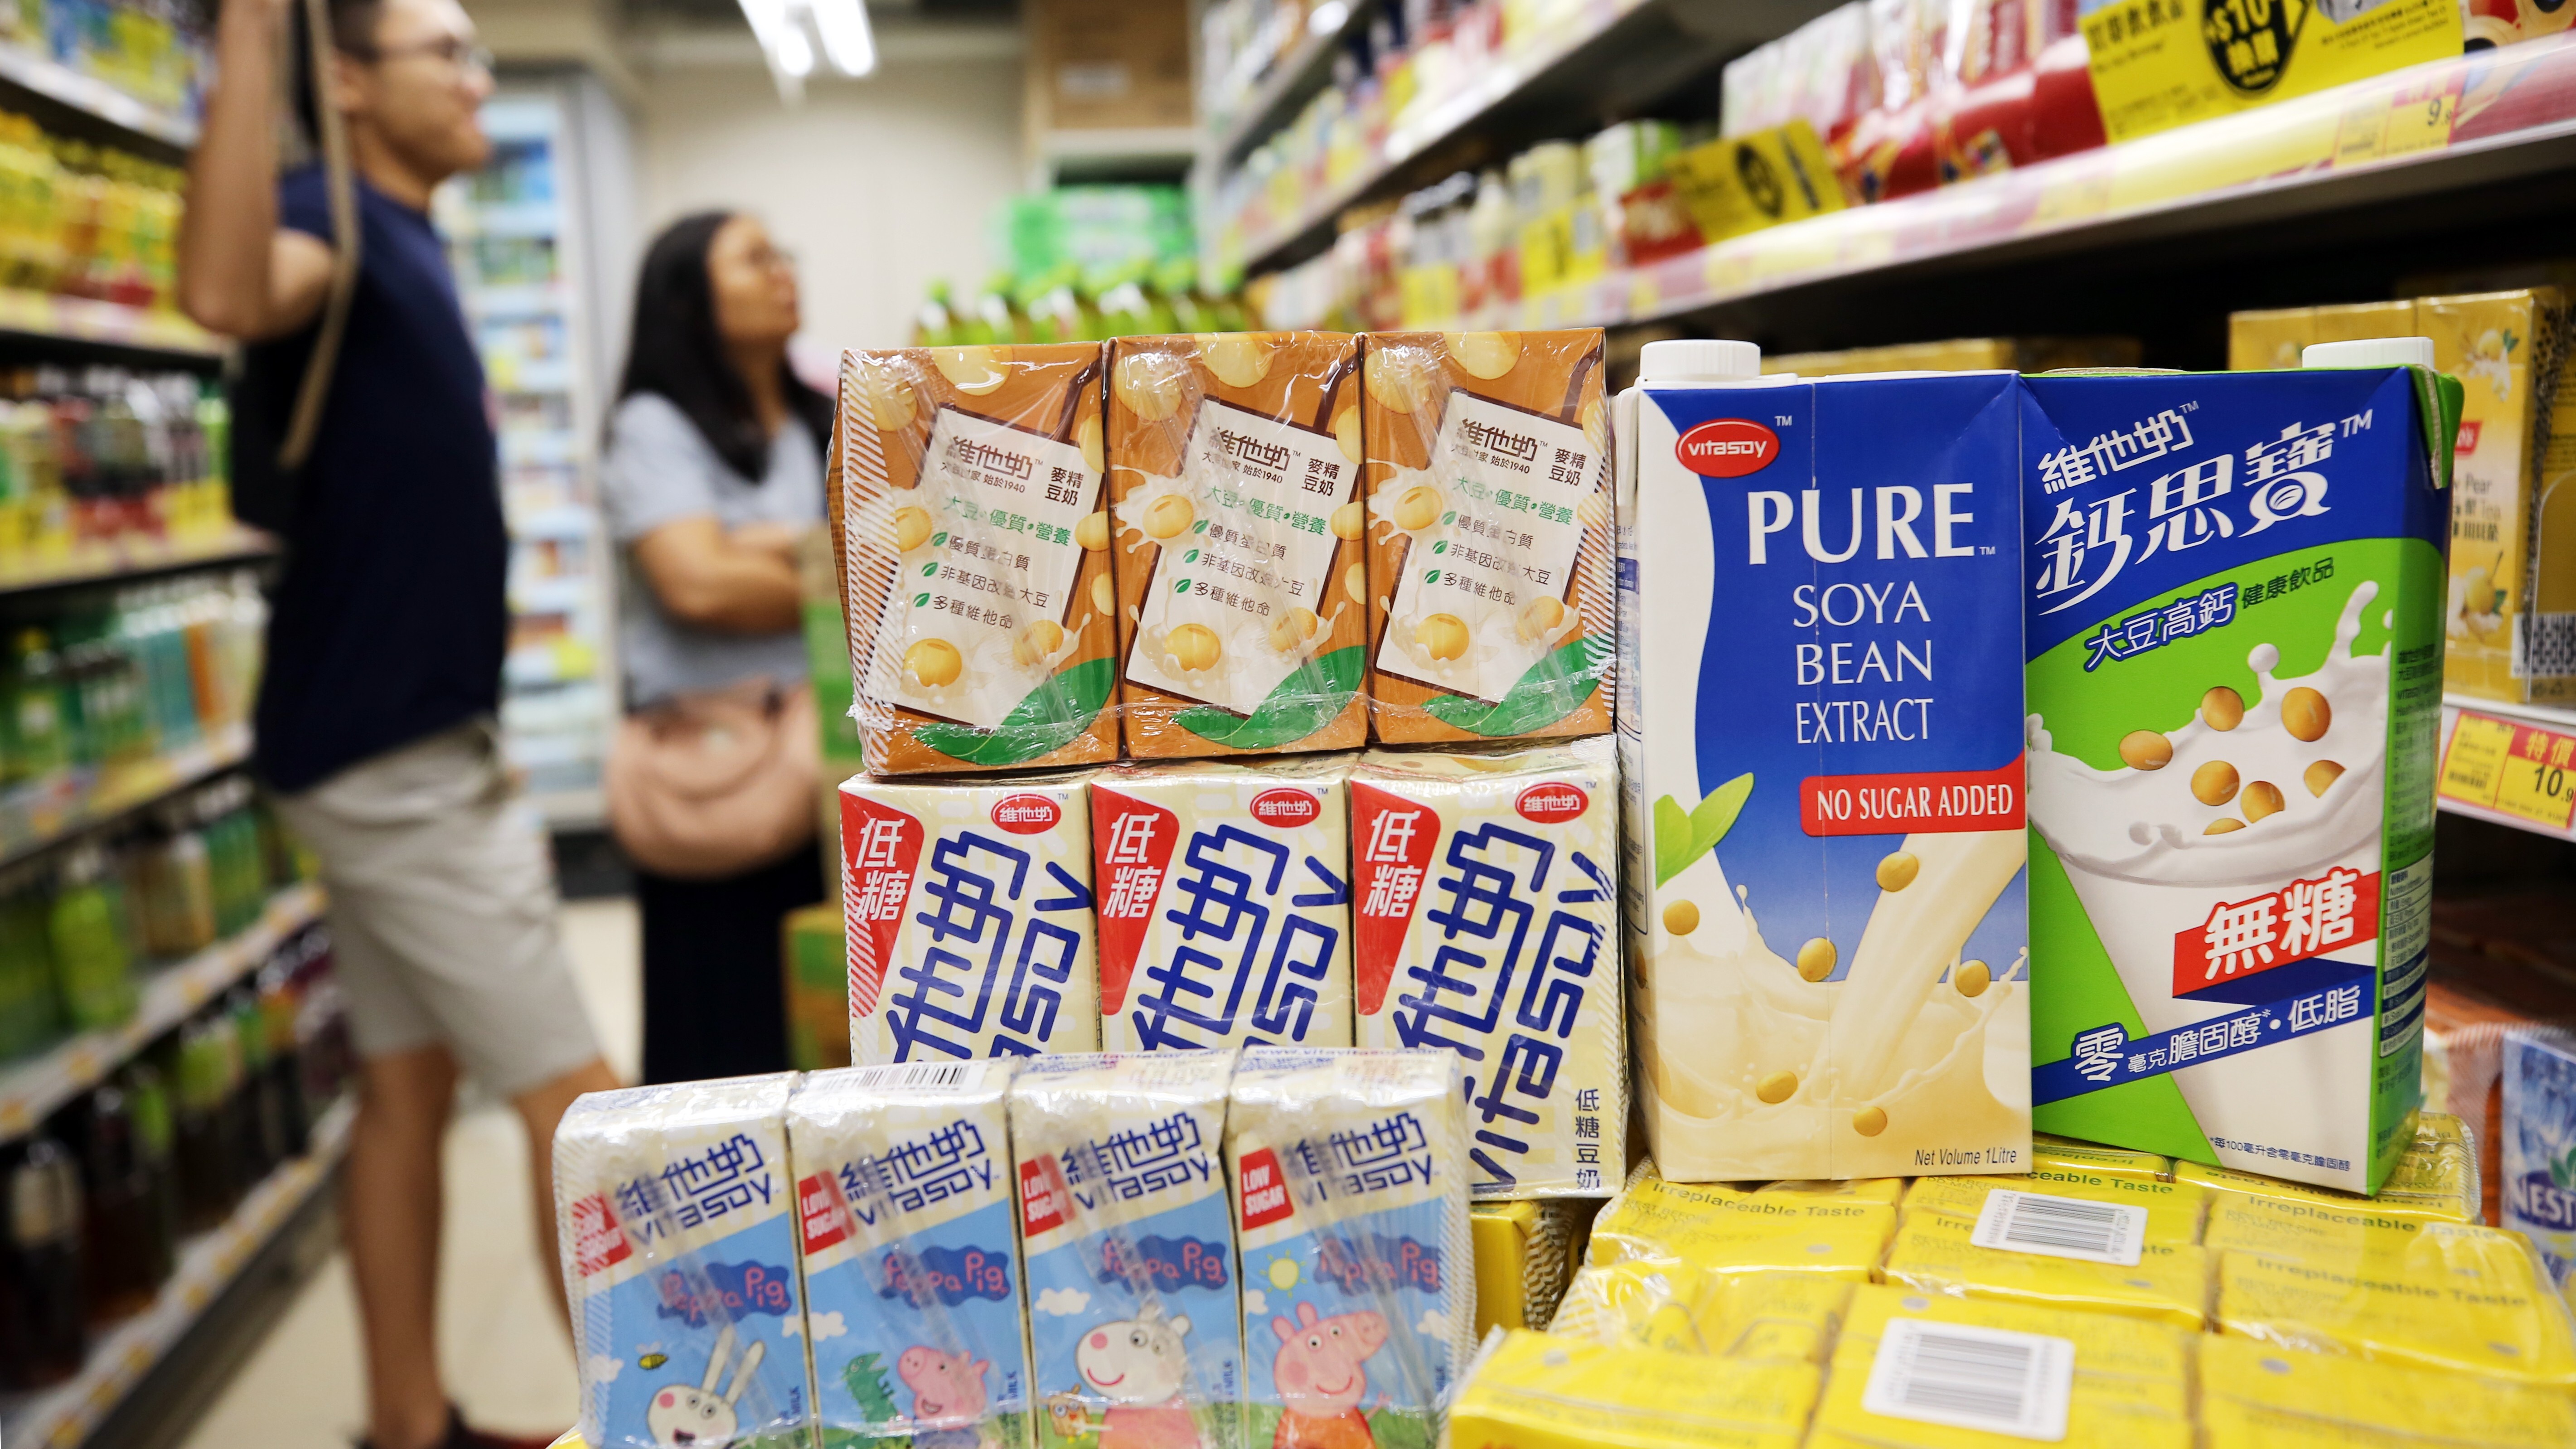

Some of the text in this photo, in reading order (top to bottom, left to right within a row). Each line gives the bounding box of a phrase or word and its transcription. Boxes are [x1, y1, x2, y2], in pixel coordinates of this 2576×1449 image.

[946, 435, 1033, 481] 維他奶
[1208, 427, 1291, 472] 維他奶
[1455, 418, 1538, 462] 維他奶
[1554, 448, 1587, 470] 麥精
[1687, 439, 1767, 457] vitasoy
[2037, 409, 2195, 496] 維他奶
[983, 474, 1026, 493] 始於1940
[1051, 466, 1085, 488] 麥精
[1243, 461, 1283, 484] 始於1940
[1308, 458, 1340, 480] 麥精
[1491, 455, 1530, 474] 始於1940
[1548, 464, 1581, 487] 豆奶
[1045, 486, 1079, 506] 豆奶
[1302, 474, 1334, 496] 豆奶
[1747, 482, 1975, 566] PURE
[2034, 421, 2338, 616] 鈣思寶
[1194, 582, 1271, 617] 多種維他命
[1443, 572, 1517, 606] 多種維他命
[1793, 581, 1932, 628] SOYA
[933, 595, 1013, 630] 多種維他命
[2087, 557, 2335, 669] 大豆高鈣 健康飲品
[1795, 639, 1932, 686] BEAN
[1796, 698, 1934, 745] EXTRACT
[999, 806, 1052, 823] 維他奶
[1258, 800, 1312, 816] 維他奶
[1523, 795, 1581, 813] 維他奶
[1817, 784, 2014, 821] NO SUGAR ADDED
[855, 818, 909, 921] 低糖
[1103, 812, 1162, 918] 低糖
[1362, 809, 1422, 918] 低糖
[2203, 870, 2358, 981] 無糖
[1061, 1111, 1202, 1186] 維他奶
[1575, 1088, 1601, 1190] 低糖豆奶
[1914, 1149, 1935, 1166] Net
[1939, 1148, 1980, 1165] Volume
[615, 1134, 765, 1216] 維他奶
[839, 1119, 988, 1201] 維他奶
[1242, 1163, 1270, 1194] LOW
[1244, 1183, 1286, 1217] SUGAR
[1651, 1182, 1866, 1218] Irreplaceable Taste
[2110, 1178, 2174, 1194] Taste
[2249, 1196, 2416, 1232] Irreplaceable
[884, 1251, 1005, 1304] Pepa Pig
[1103, 1240, 1222, 1283] Pepa Pig
[1320, 1236, 1439, 1289] Ppa Pig
[745, 1266, 786, 1307] Pig
[2256, 1258, 2440, 1300] Irreplaceable
[2447, 1288, 2528, 1307] Taste
